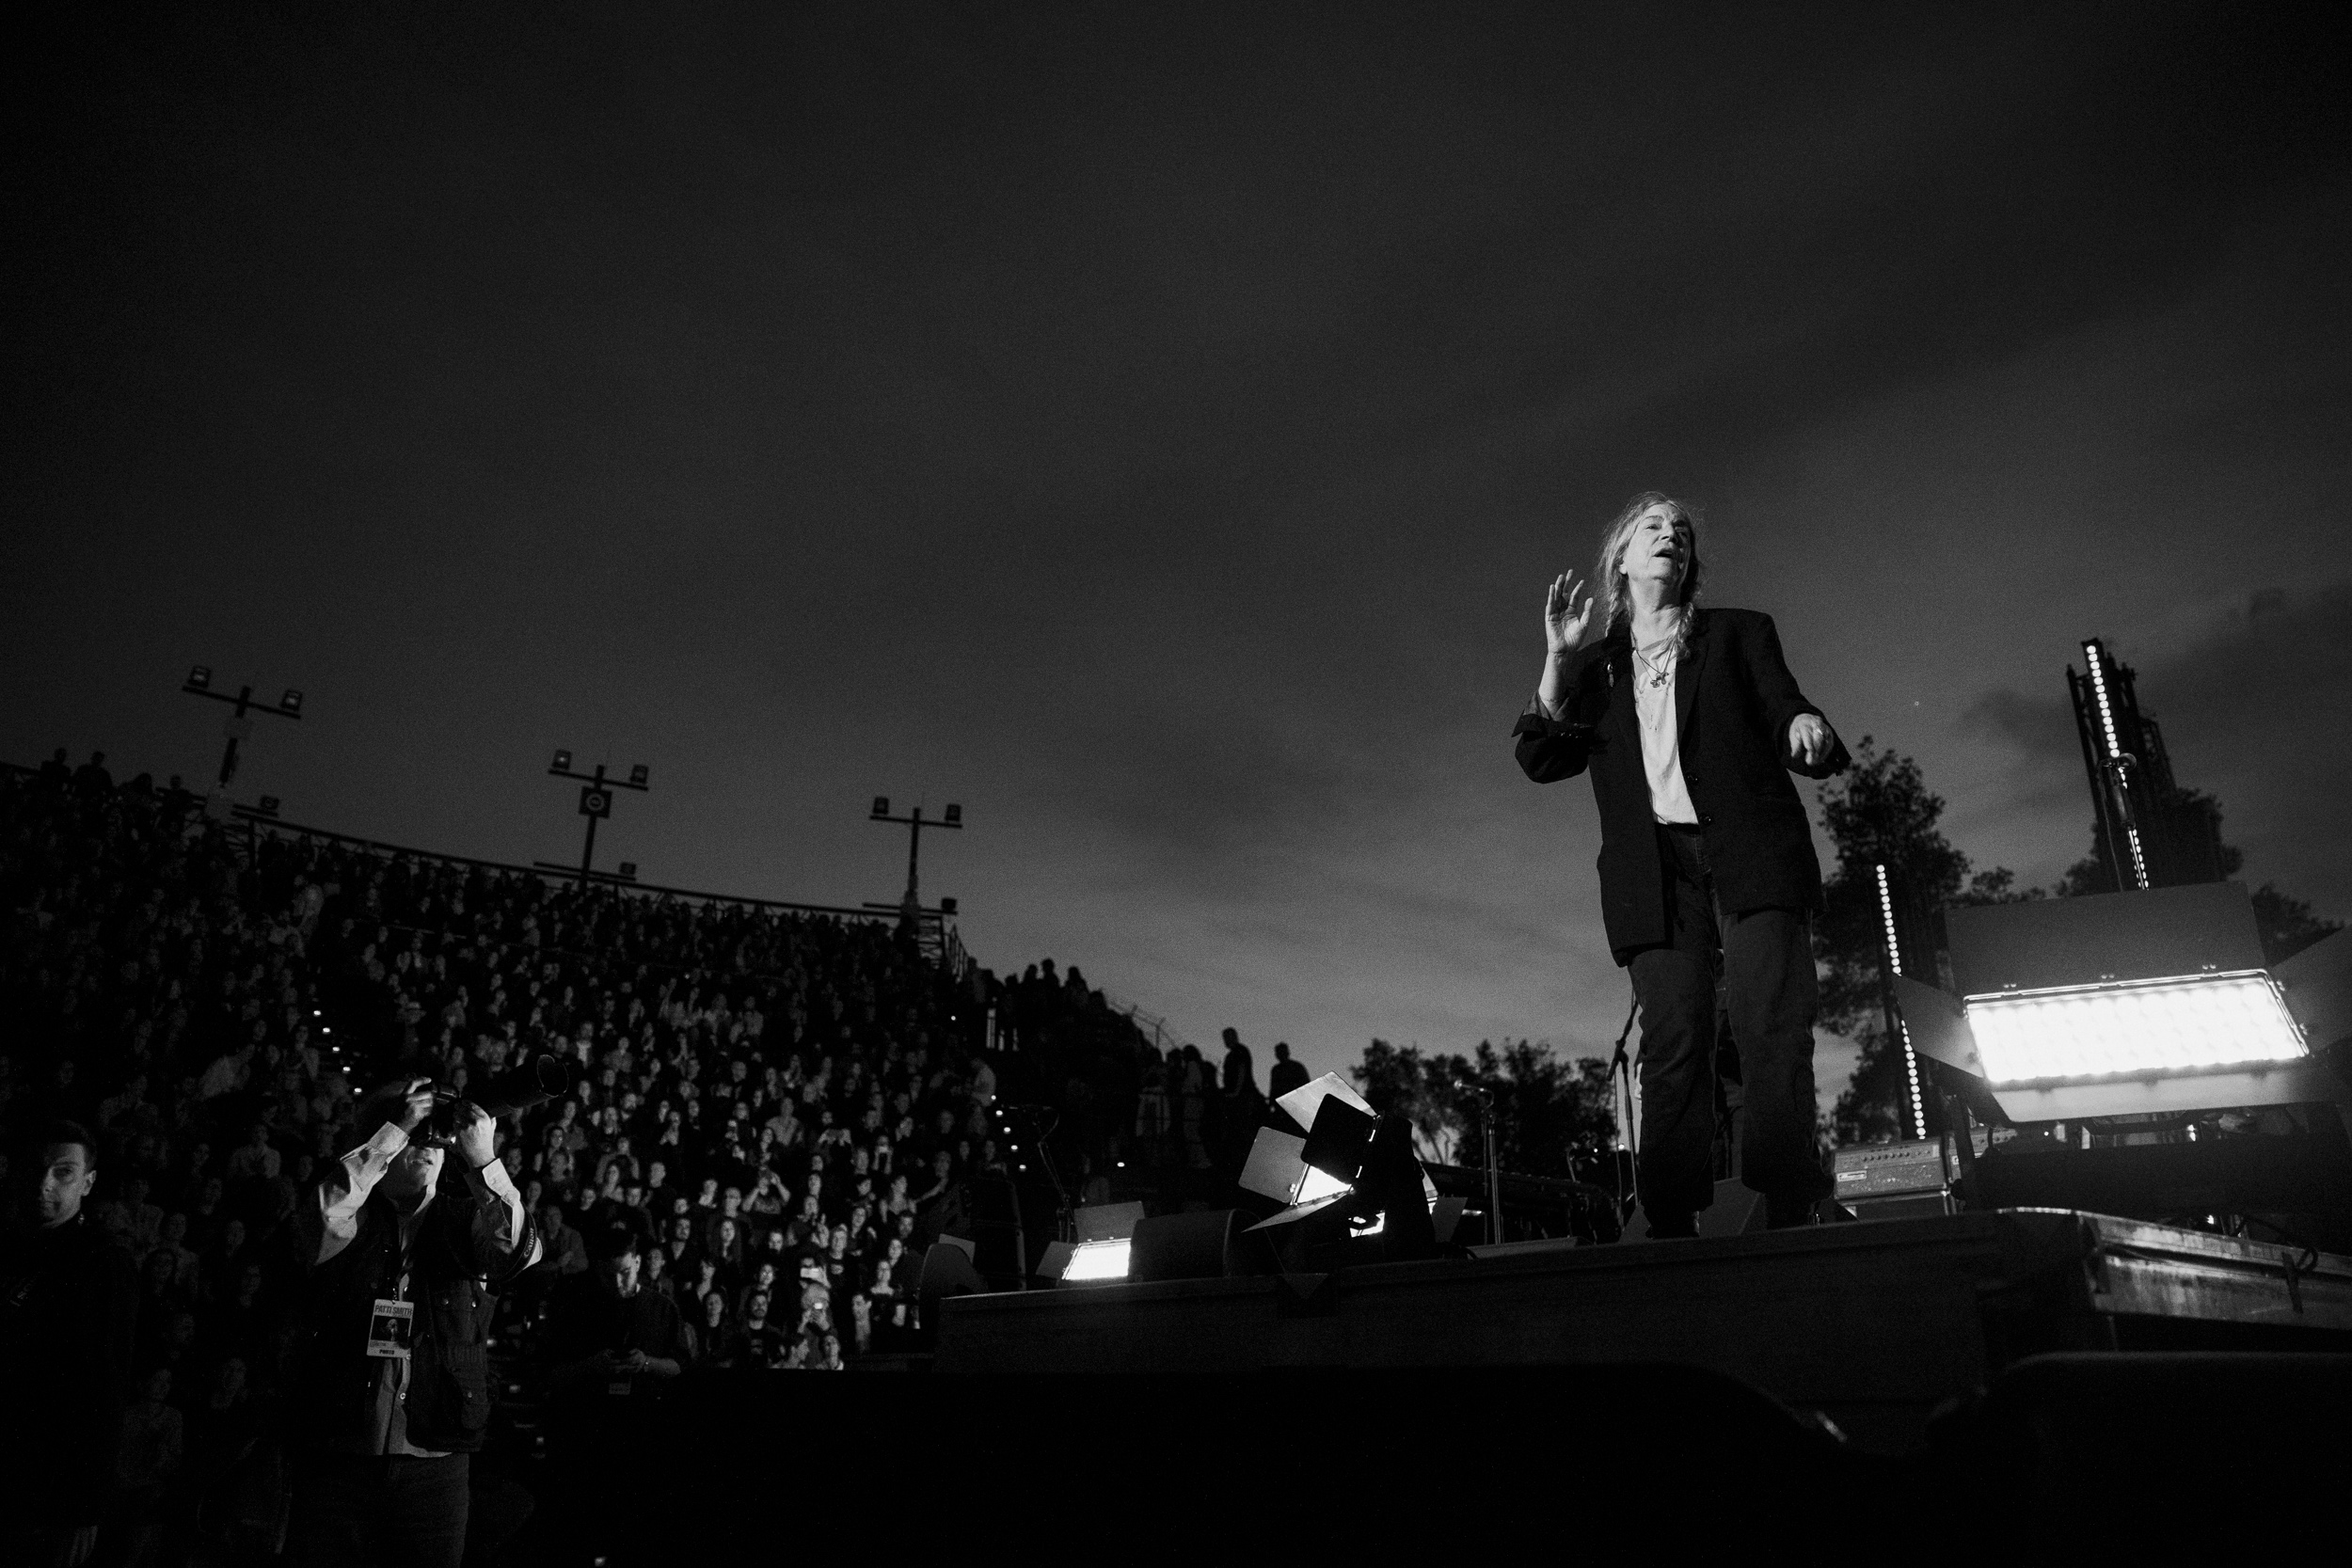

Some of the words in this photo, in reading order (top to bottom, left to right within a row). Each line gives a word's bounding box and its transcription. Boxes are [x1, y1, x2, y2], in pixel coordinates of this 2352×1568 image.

[524, 1227, 534, 1259] Canon
[375, 1305, 391, 1314] PATTI
[392, 1307, 412, 1316] SMITH
